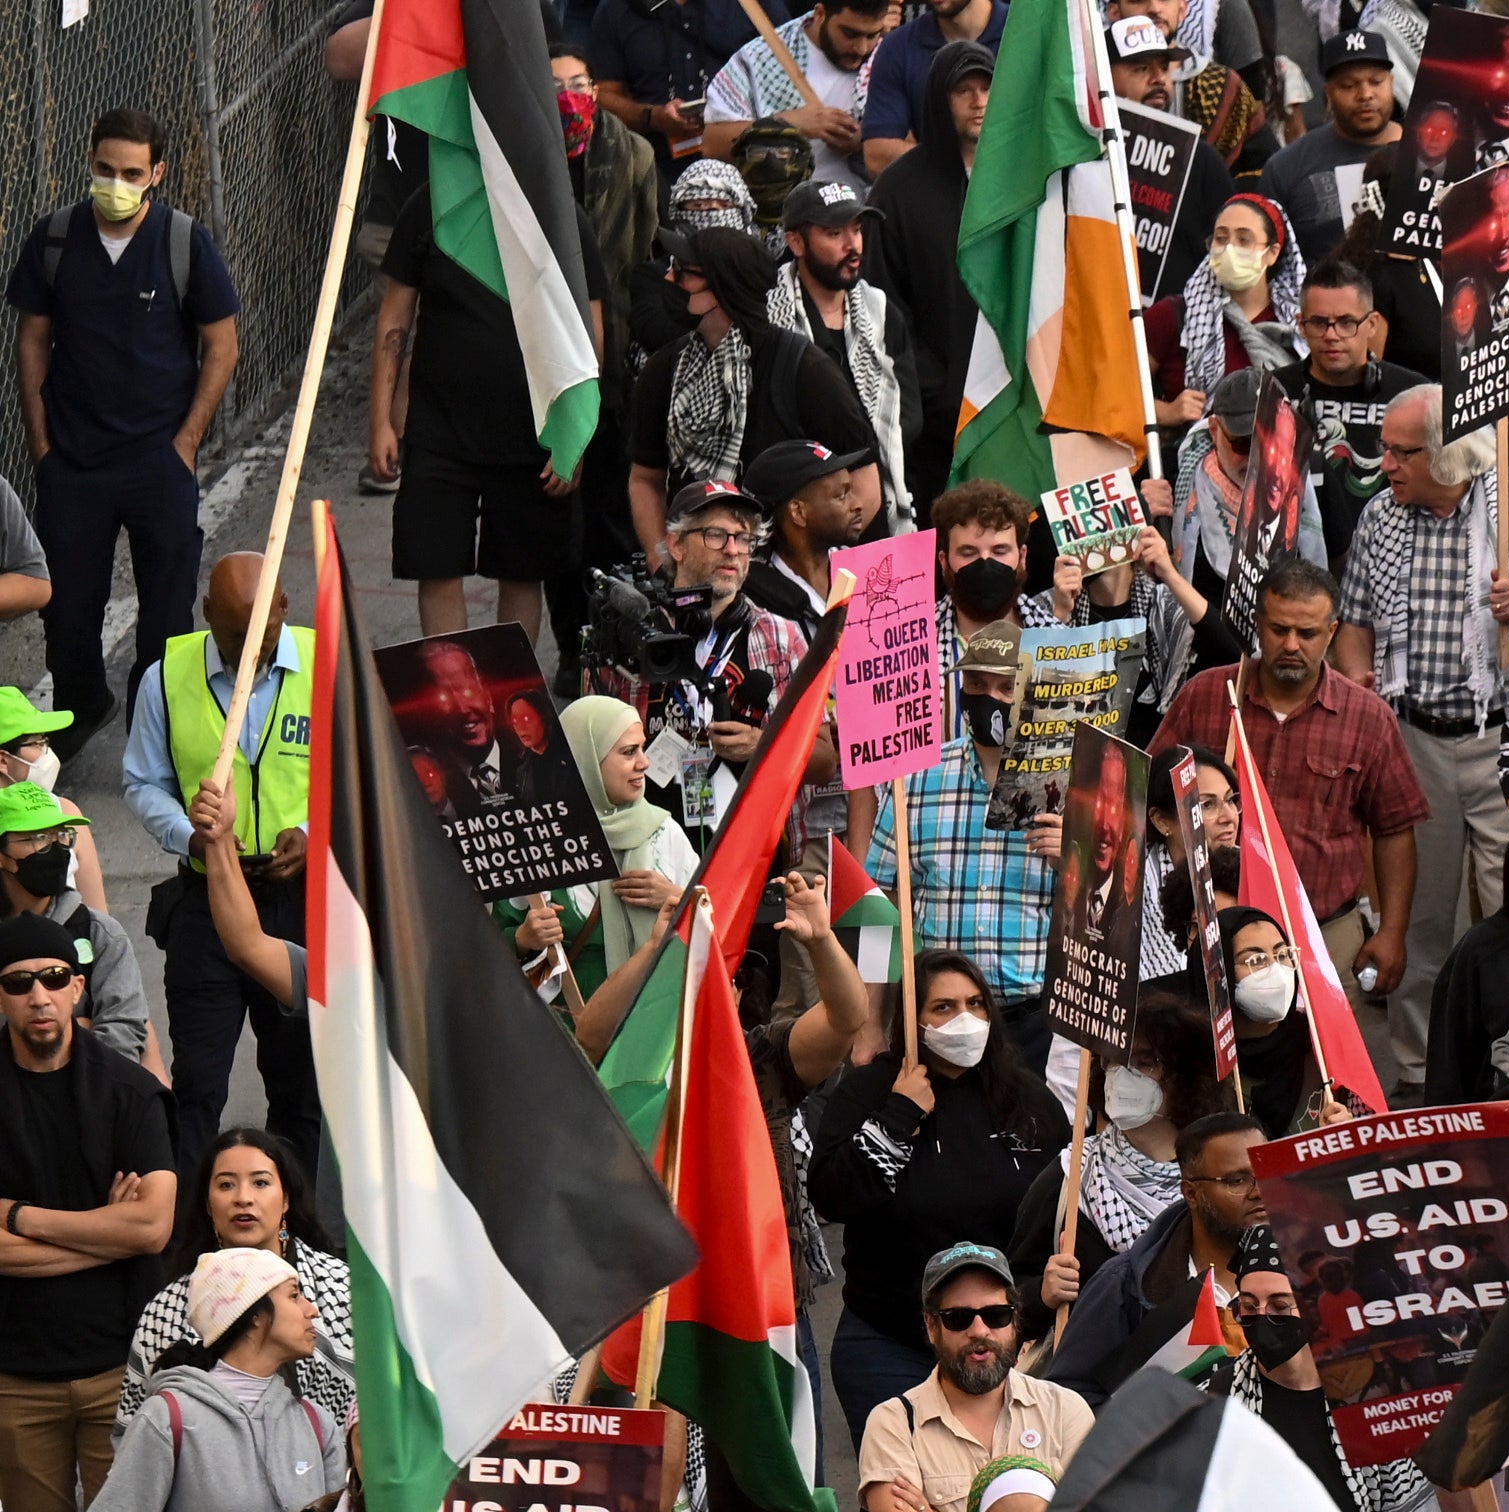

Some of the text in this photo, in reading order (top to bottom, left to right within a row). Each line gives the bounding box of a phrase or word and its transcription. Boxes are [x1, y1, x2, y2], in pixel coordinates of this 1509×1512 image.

[1054, 473, 1120, 518] FREE
[1050, 497, 1144, 548] PALESTINE
[884, 617, 928, 650] QUEER
[1037, 638, 1129, 661] ISRAEL HAS
[845, 644, 929, 685] LIBERATION
[873, 672, 931, 705] MEANS A
[1034, 675, 1118, 699] MURDERED
[896, 696, 932, 727] FREE
[850, 723, 933, 767] PALESTINE
[1294, 1111, 1485, 1162] FREE PALESTINE
[1348, 1159, 1463, 1200] END
[1324, 1199, 1508, 1248] U.S. AID
[468, 1458, 581, 1486] END
